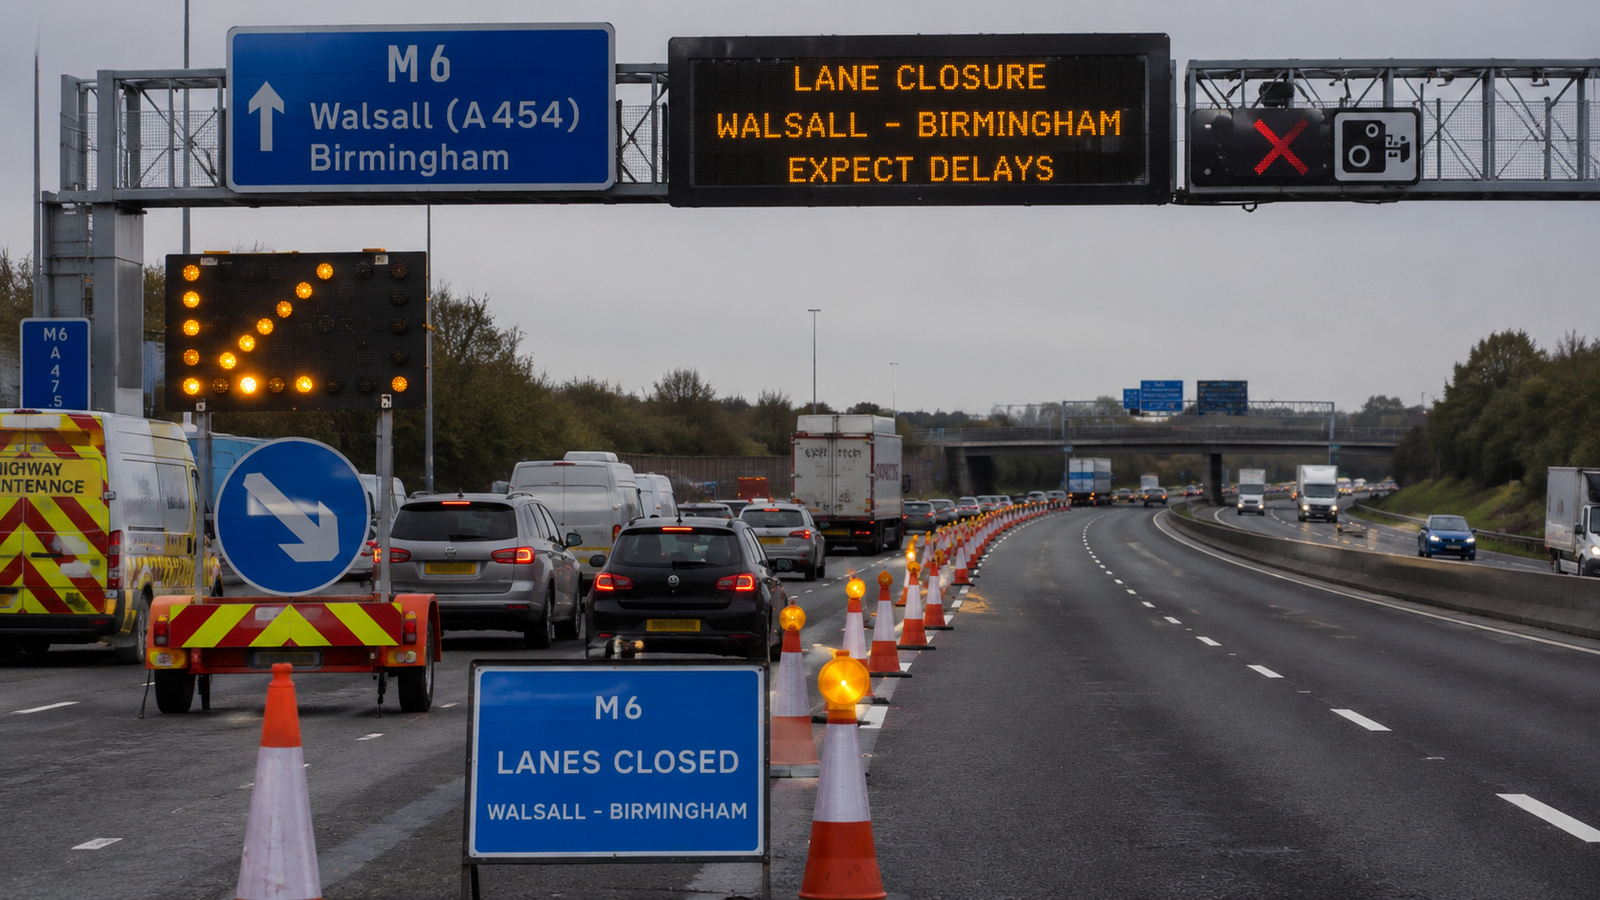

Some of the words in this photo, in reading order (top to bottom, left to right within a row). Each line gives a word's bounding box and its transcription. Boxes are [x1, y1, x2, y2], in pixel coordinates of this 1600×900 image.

[794, 64, 880, 92] LANE
[896, 63, 1046, 91] CLOSURE
[310, 102, 433, 130] Walsall
[717, 111, 868, 139] WALSALL
[918, 109, 1121, 138] BIRMINGHAM
[311, 143, 509, 177] Birmingham
[788, 156, 914, 183] EXPECT
[930, 155, 1054, 182] DELAYS
[43, 327, 68, 341] M6
[497, 750, 601, 775] LANES
[613, 749, 740, 774] CLOSED
[487, 803, 587, 821] WALSALL
[609, 802, 748, 820] BIRMINGHAM
